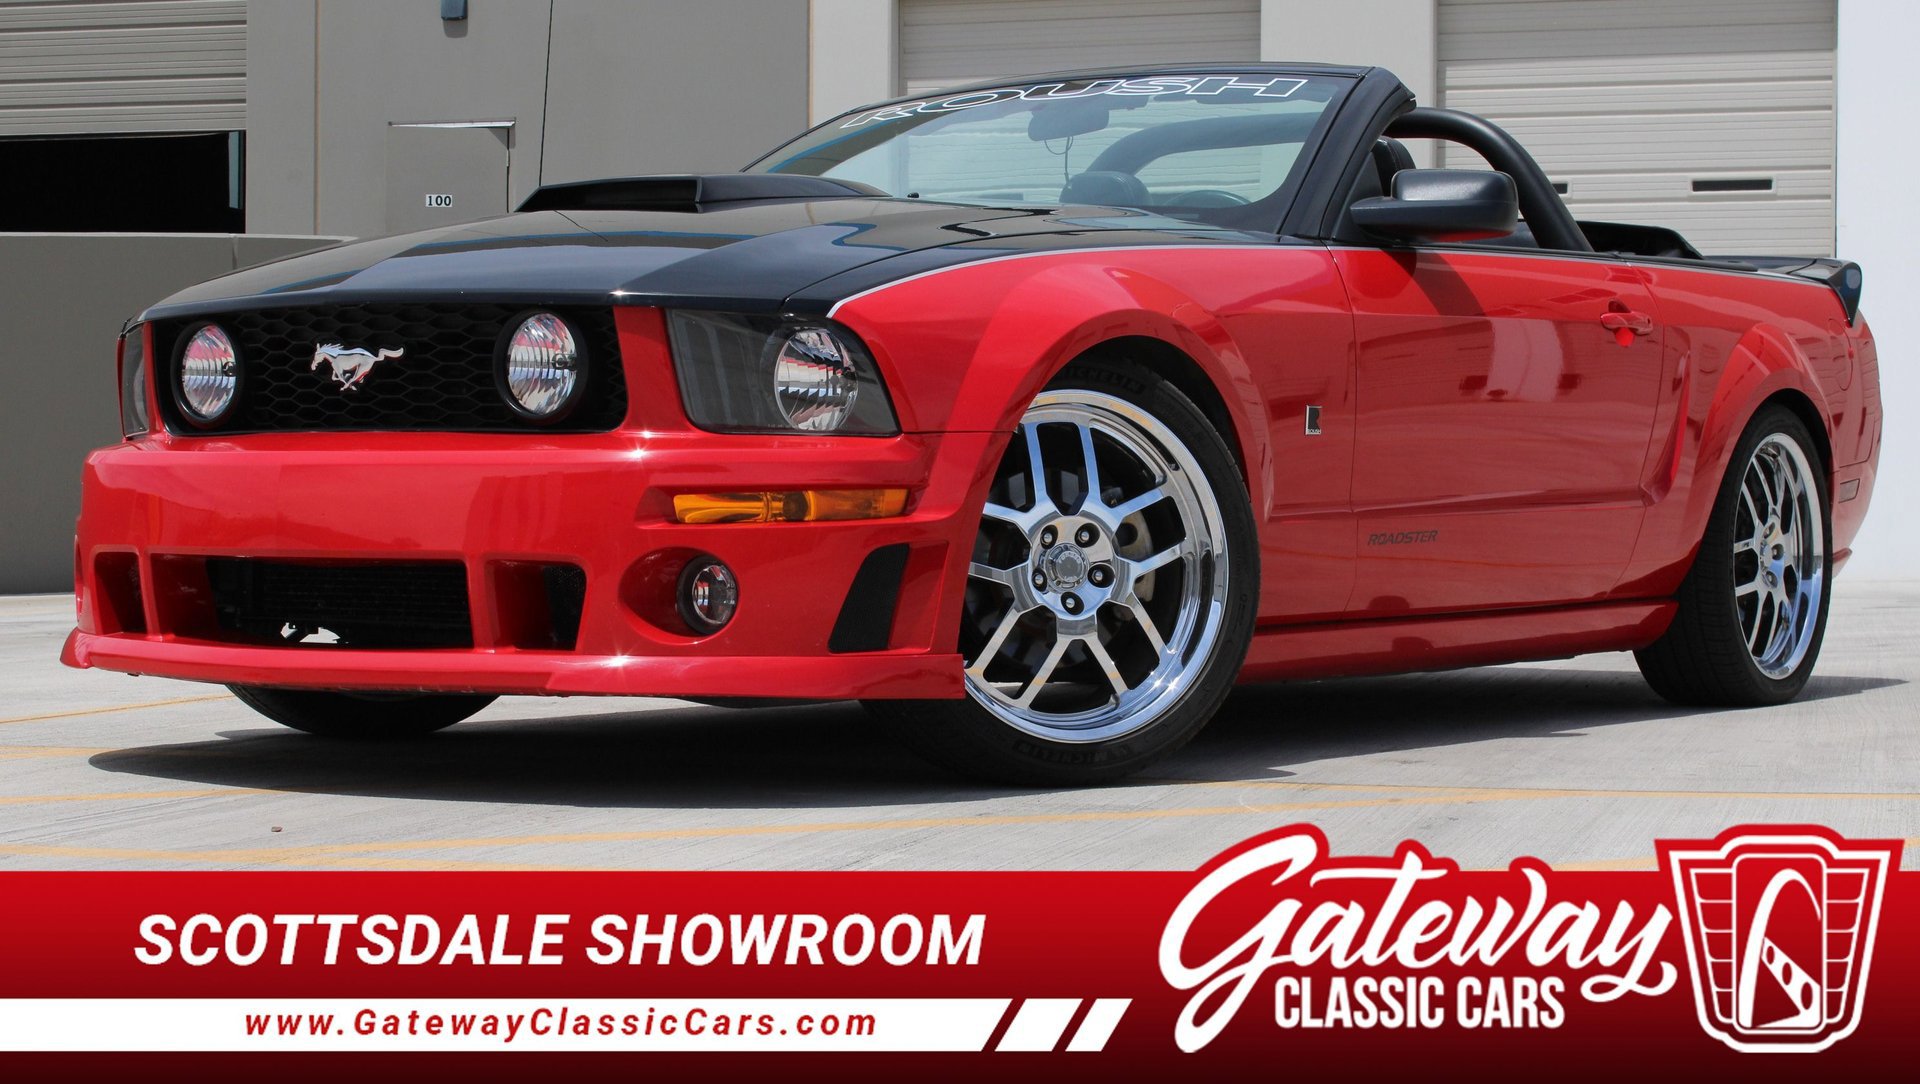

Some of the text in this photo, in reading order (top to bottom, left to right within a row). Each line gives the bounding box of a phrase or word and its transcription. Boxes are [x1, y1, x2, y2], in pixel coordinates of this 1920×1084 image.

[840, 77, 1309, 129] ROUSH
[428, 195, 452, 206] 100
[1367, 529, 1439, 546] ROADSTER
